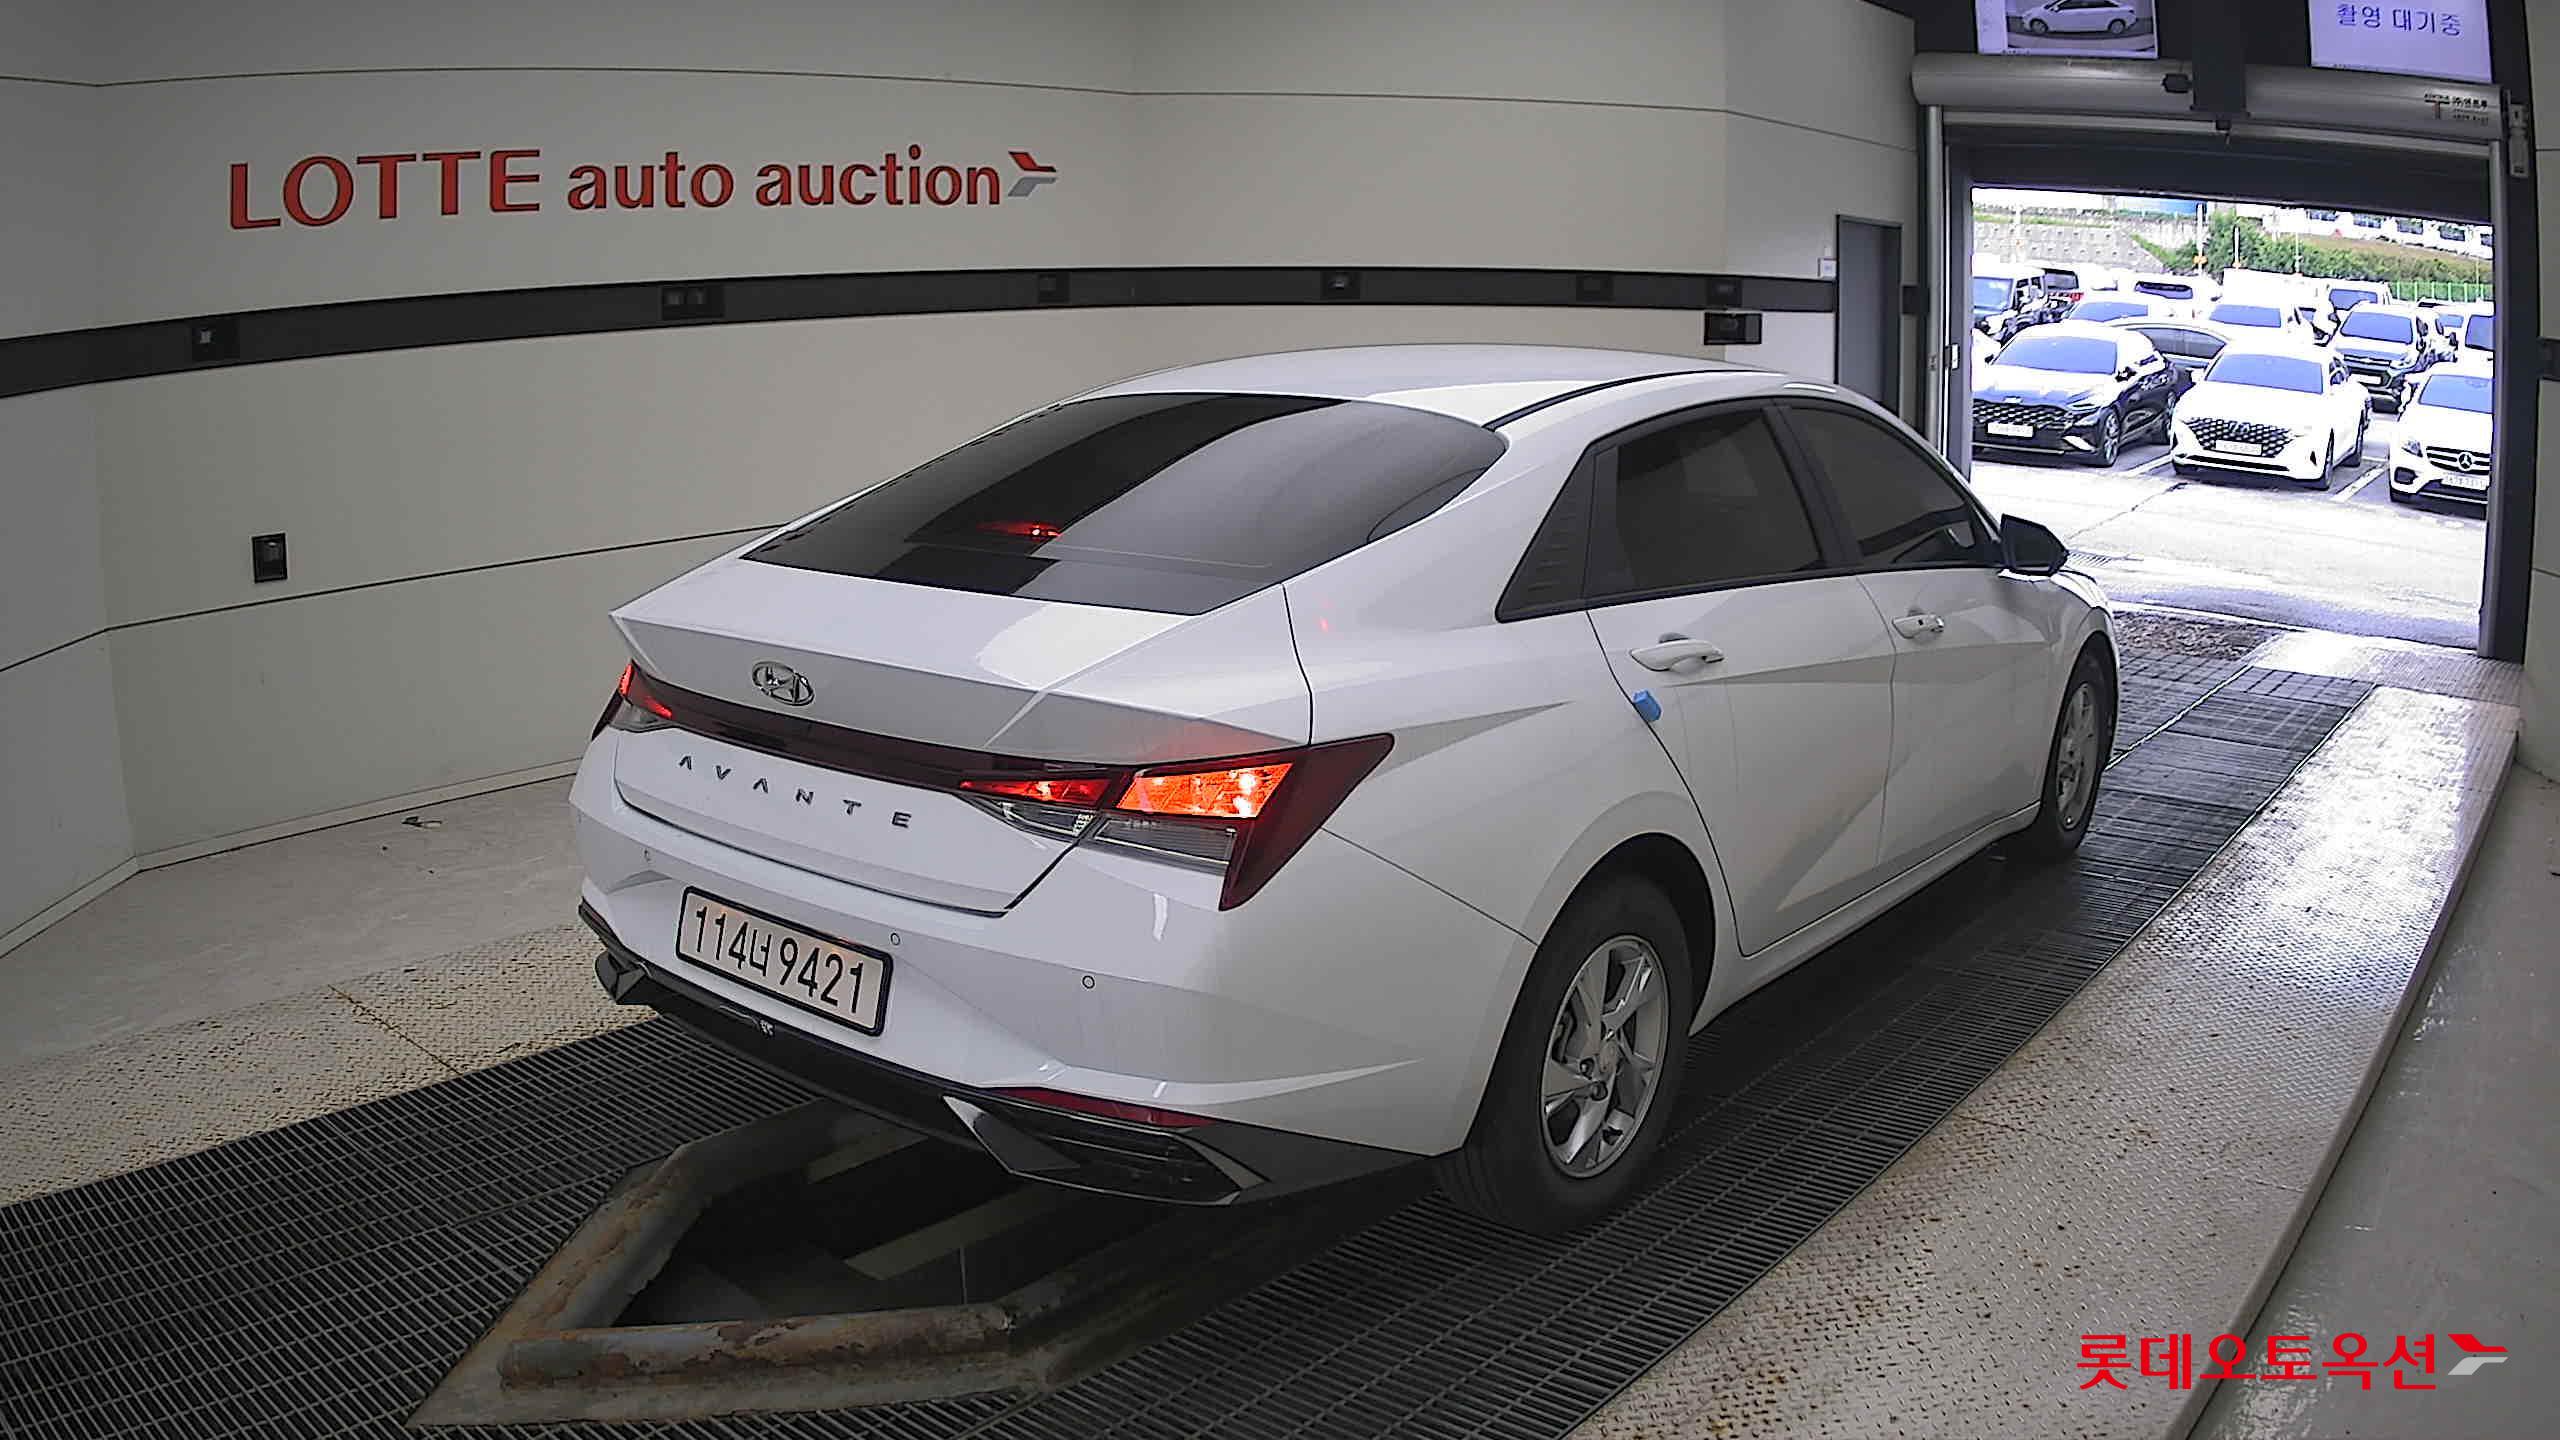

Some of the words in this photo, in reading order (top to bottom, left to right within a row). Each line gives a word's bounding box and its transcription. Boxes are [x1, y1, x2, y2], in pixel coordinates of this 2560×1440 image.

[2337, 3, 2382, 29] 촬영
[2392, 8, 2462, 37] 대기중
[229, 149, 540, 231] LOTTE
[568, 152, 735, 209] auto
[756, 145, 1003, 207] auction
[678, 755, 913, 829] AVANTE
